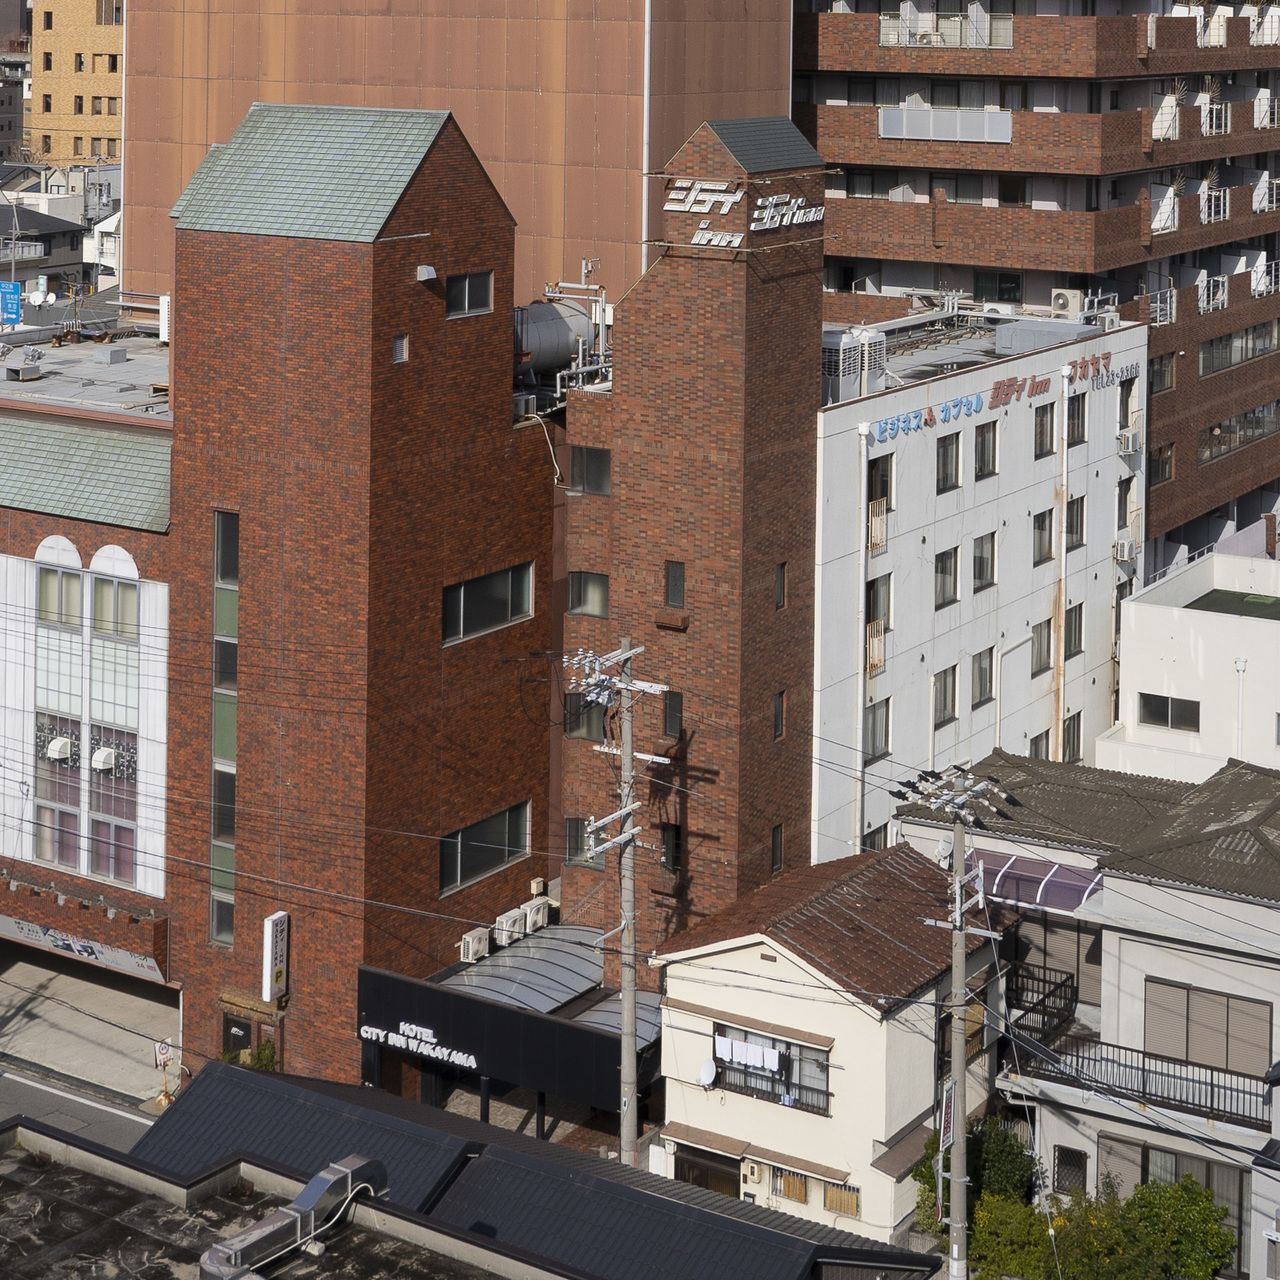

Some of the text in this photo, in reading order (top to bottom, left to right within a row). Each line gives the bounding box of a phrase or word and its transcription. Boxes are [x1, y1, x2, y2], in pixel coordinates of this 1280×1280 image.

[691, 219, 745, 248] inn
[1027, 374, 1052, 399] inn
[399, 1021, 438, 1044] HOTEL
[360, 1025, 478, 1069] CITY INN WAKAYAMA
